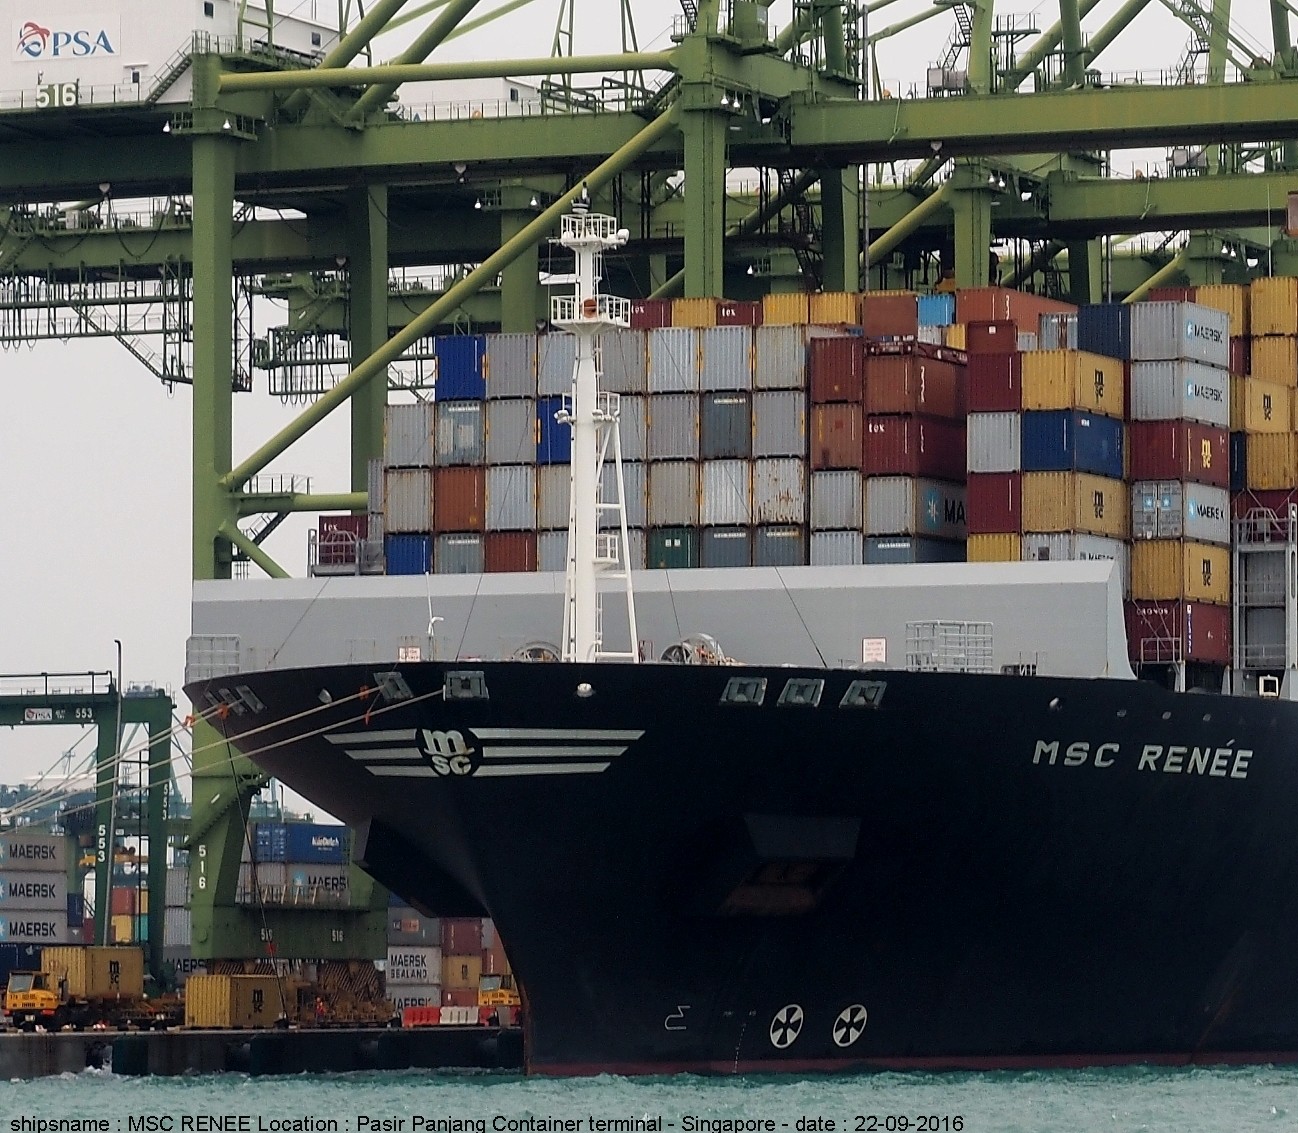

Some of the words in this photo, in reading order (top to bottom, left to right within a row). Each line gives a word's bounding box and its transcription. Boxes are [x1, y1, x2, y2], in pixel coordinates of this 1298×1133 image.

[52, 30, 114, 56] PSA
[36, 84, 76, 108] 516
[75, 708, 93, 719] 553
[1032, 740, 1119, 768] MSC
[1138, 739, 1253, 779] RENÉE
[98, 825, 106, 863] 553
[9, 844, 56, 860] MAERSK
[198, 844, 206, 889] 516
[9, 883, 56, 898] MAERSK
[308, 876, 349, 891] MAERS
[9, 922, 56, 937] MAERSK
[332, 929, 344, 942] 516
[390, 954, 427, 967] MAERSK
[390, 969, 427, 979] SEALAND
